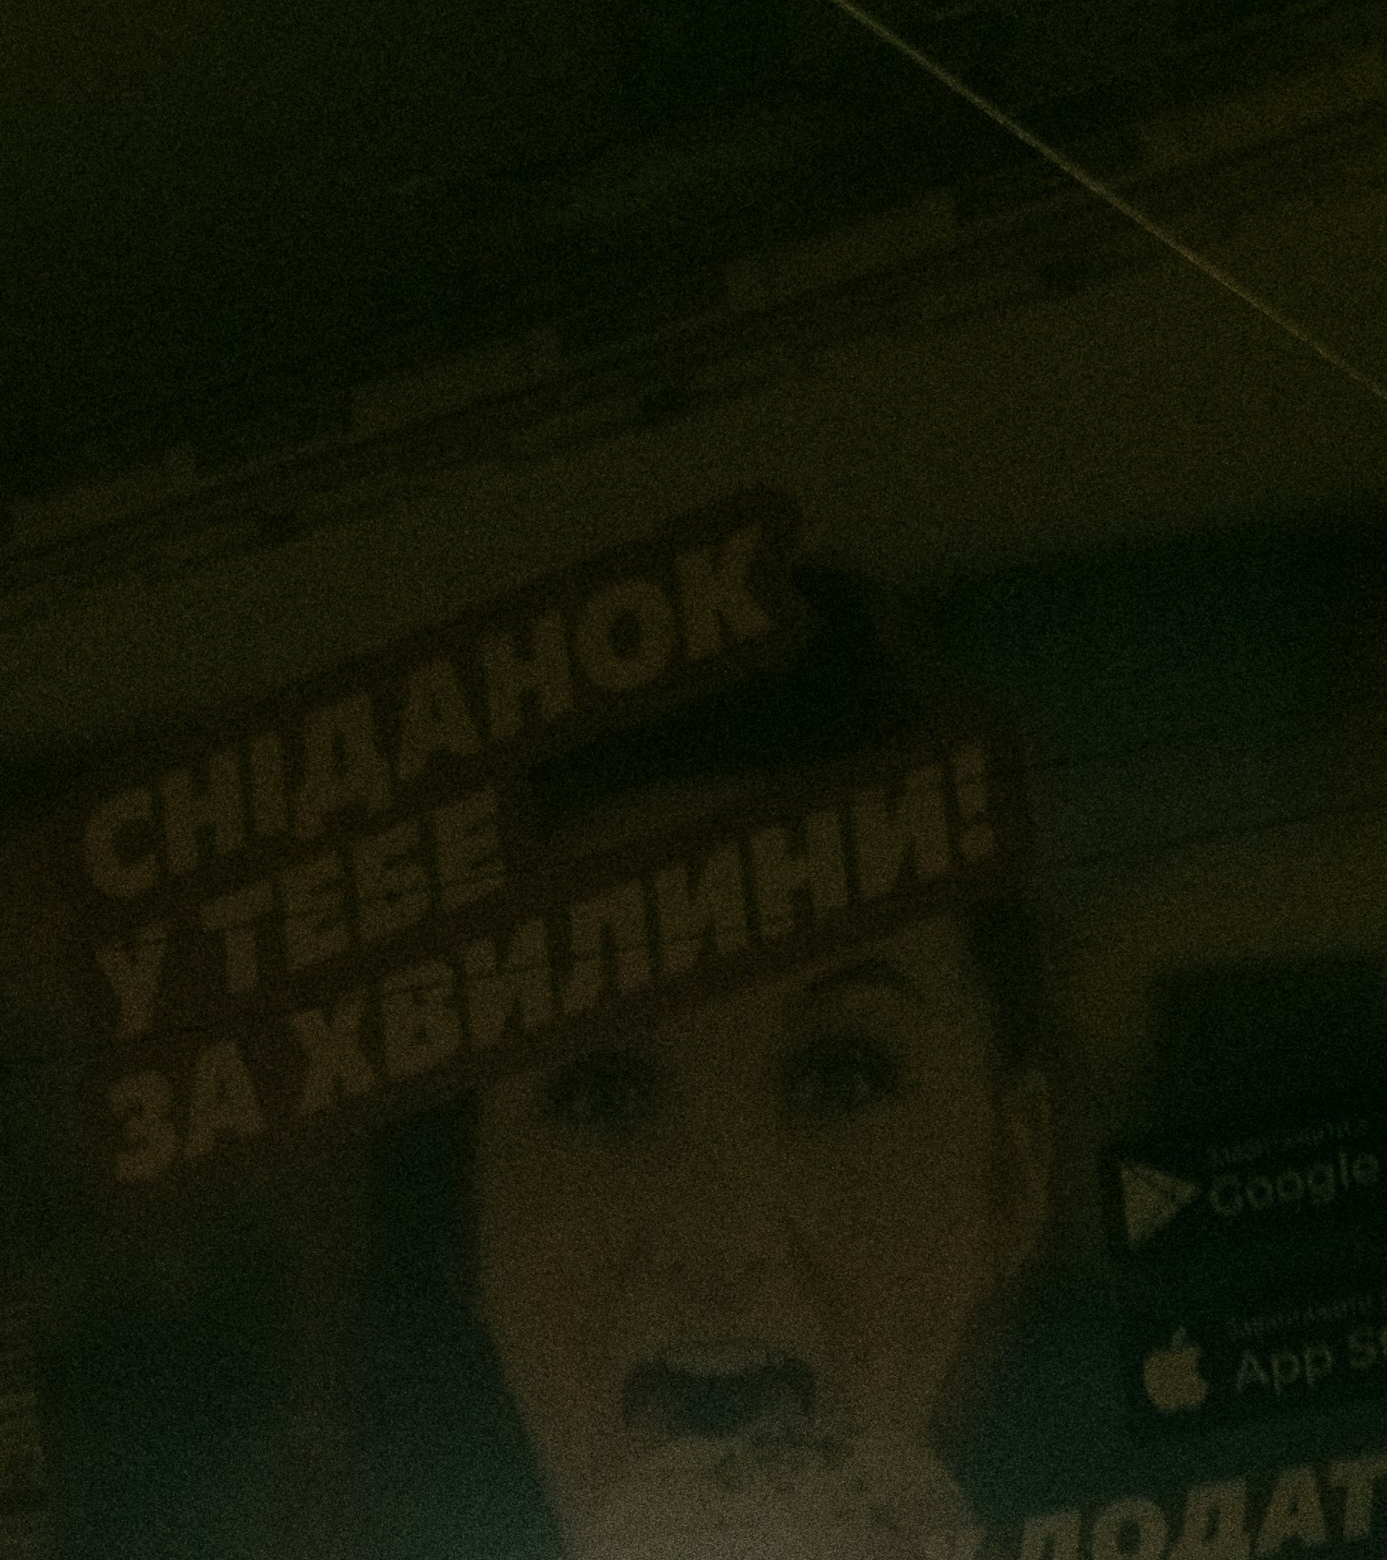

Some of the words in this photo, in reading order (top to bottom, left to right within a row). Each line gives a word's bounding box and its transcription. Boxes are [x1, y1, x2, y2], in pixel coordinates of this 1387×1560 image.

[82, 524, 772, 902] СНІДАНОК
[95, 926, 168, 1038] У
[200, 783, 506, 994] ТЕБЕ
[110, 1039, 265, 1184] ЗА
[287, 741, 997, 1116] ХВИЛИНИ!
[1207, 1145, 1381, 1218] Google
[1235, 1341, 1335, 1393] App
